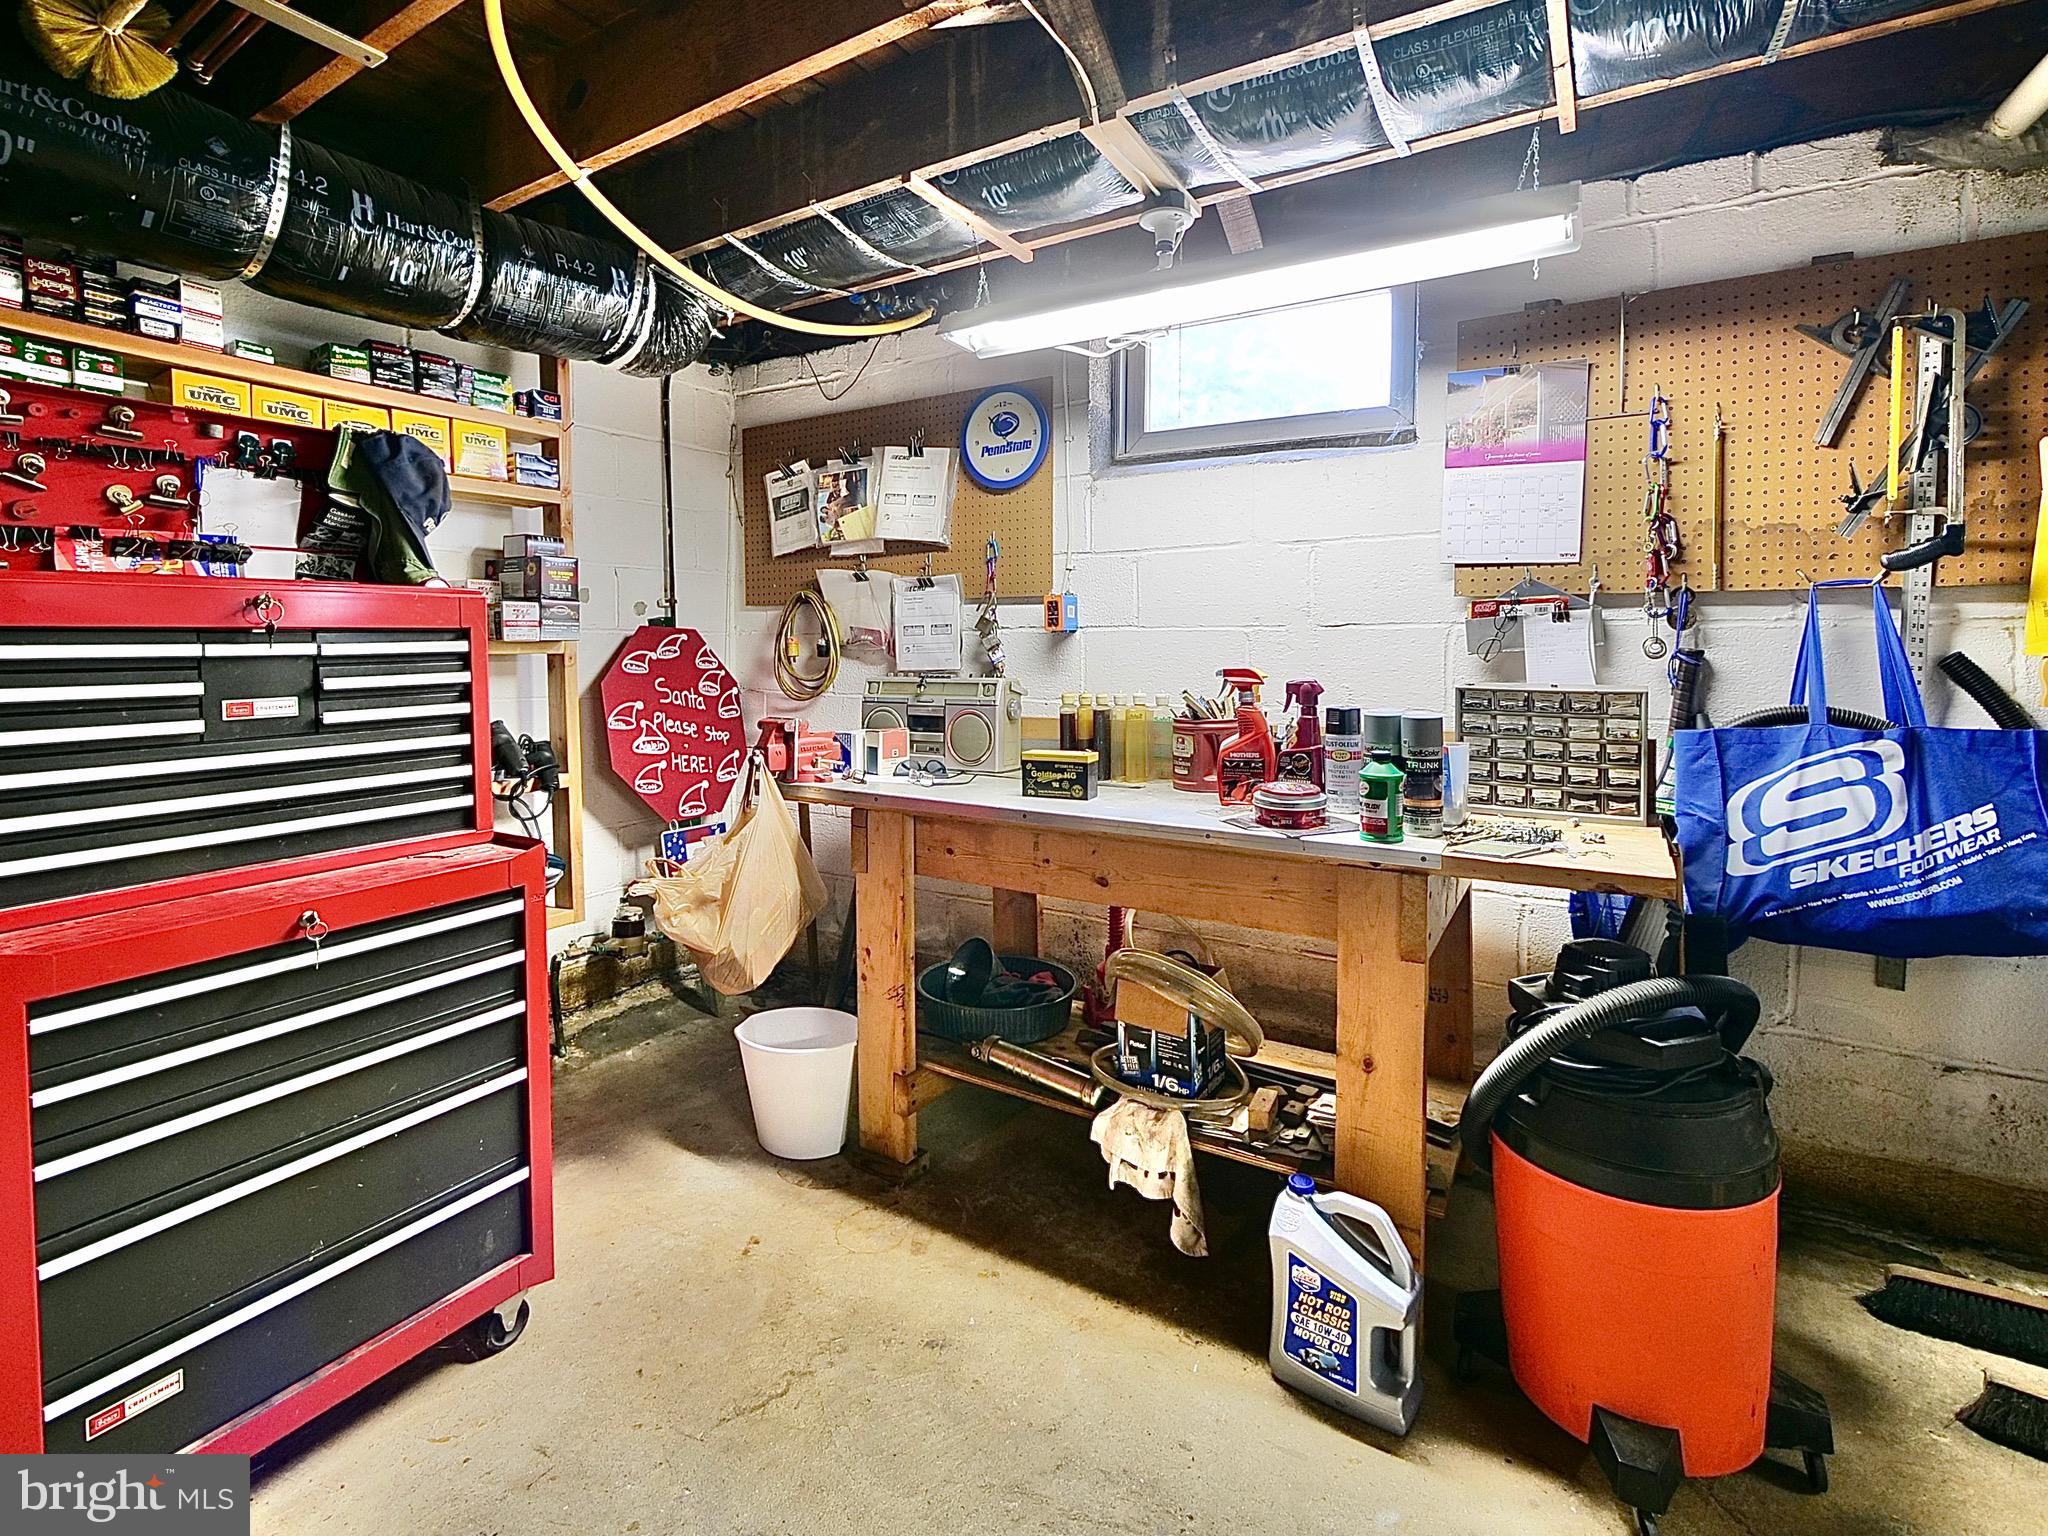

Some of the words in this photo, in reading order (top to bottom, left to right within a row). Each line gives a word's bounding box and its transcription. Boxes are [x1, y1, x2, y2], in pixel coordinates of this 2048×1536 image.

[1393, 39, 1429, 58] CLASS
[1440, 20, 1495, 46] FLEXIBLE
[1497, 12, 1516, 29] AIR
[178, 157, 219, 179] CLASS
[982, 181, 1012, 209] 10"
[389, 256, 427, 286] 10"
[555, 253, 597, 278] R-4.2
[784, 247, 807, 271] 10"
[140, 298, 178, 311] MAGTECH
[189, 389, 236, 406] UMC
[543, 394, 558, 404] CCI
[267, 404, 309, 420] UMC
[405, 427, 440, 439] UMC
[465, 436, 498, 448] UMC
[981, 439, 1033, 458] PennState
[655, 678, 707, 710] Santa
[653, 711, 699, 737] Please
[704, 725, 730, 745] Stop
[671, 752, 714, 774] HERE!
[1406, 760, 1440, 769] TRUNK
[1790, 803, 1997, 889] SKECHERS
[1899, 828, 2001, 878] FOOTWEAR
[1842, 890, 1869, 900] Toronto
[1874, 884, 1899, 895] London
[1904, 878, 1922, 888] Paris
[1961, 852, 1984, 867] Madrid
[1986, 845, 2004, 857] Tokyo
[2007, 837, 2022, 848] Hong
[2021, 831, 2038, 843] Kong
[1867, 875, 1963, 909] WWW.SKECHERS.COM
[1151, 1073, 1179, 1093] 1/6
[1178, 1087, 1190, 1095] HP
[1292, 1301, 1300, 1311] &
[1300, 1304, 1351, 1332] CLASSIC
[1298, 1291, 1325, 1309] HOT
[1325, 1302, 1351, 1320] ROD
[1293, 1325, 1330, 1349] MOTOR
[1331, 1342, 1350, 1358] OIL
[1294, 1314, 1310, 1328] SAE
[1313, 1322, 1347, 1343] 10W-40
